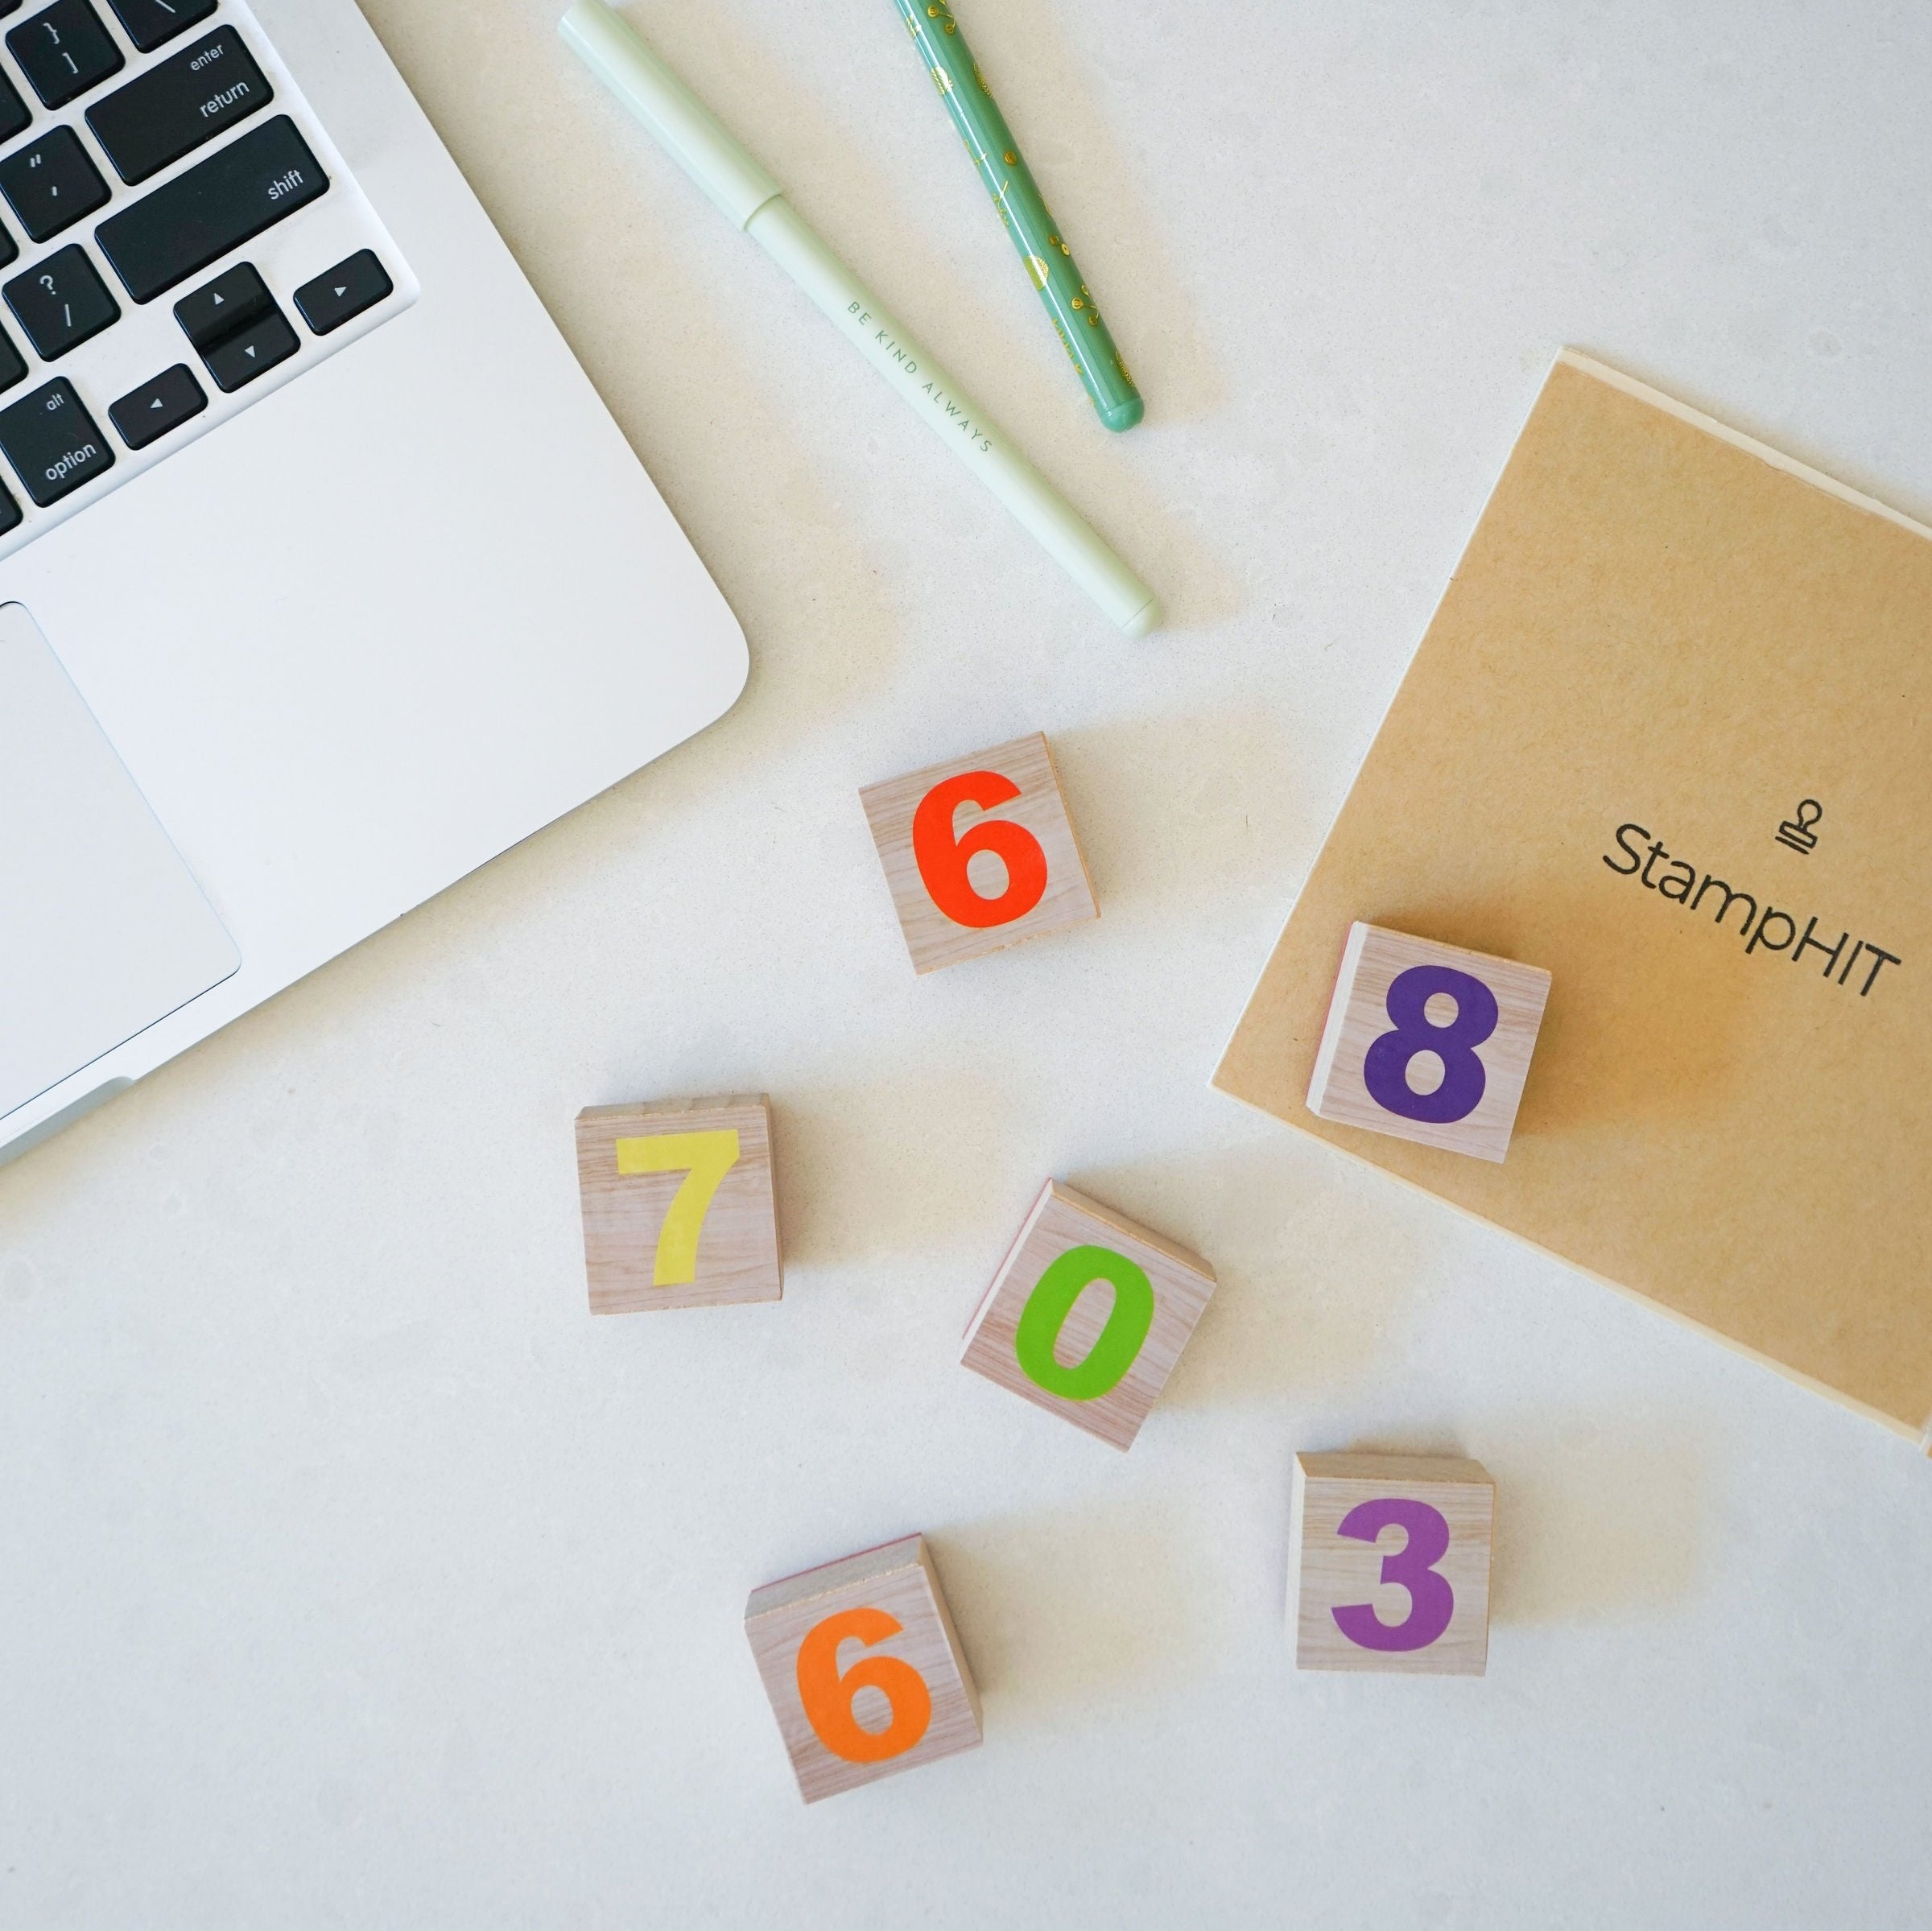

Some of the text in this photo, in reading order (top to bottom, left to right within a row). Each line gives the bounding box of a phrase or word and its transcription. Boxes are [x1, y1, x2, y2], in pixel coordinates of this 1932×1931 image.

[190, 43, 225, 71] enter
[200, 82, 250, 118] return
[267, 169, 304, 200] shift
[39, 274, 57, 295] ?
[46, 392, 64, 411] alt
[848, 301, 992, 452] BE KIND ALWAYS
[45, 444, 97, 481] option
[911, 770, 1048, 931] 6
[1602, 823, 1902, 997] StampHIT
[1364, 966, 1497, 1123] 8
[615, 1129, 741, 1287] 7
[1013, 1245, 1154, 1403] 0
[1332, 1500, 1452, 1650] 3
[796, 1607, 933, 1765] 6
